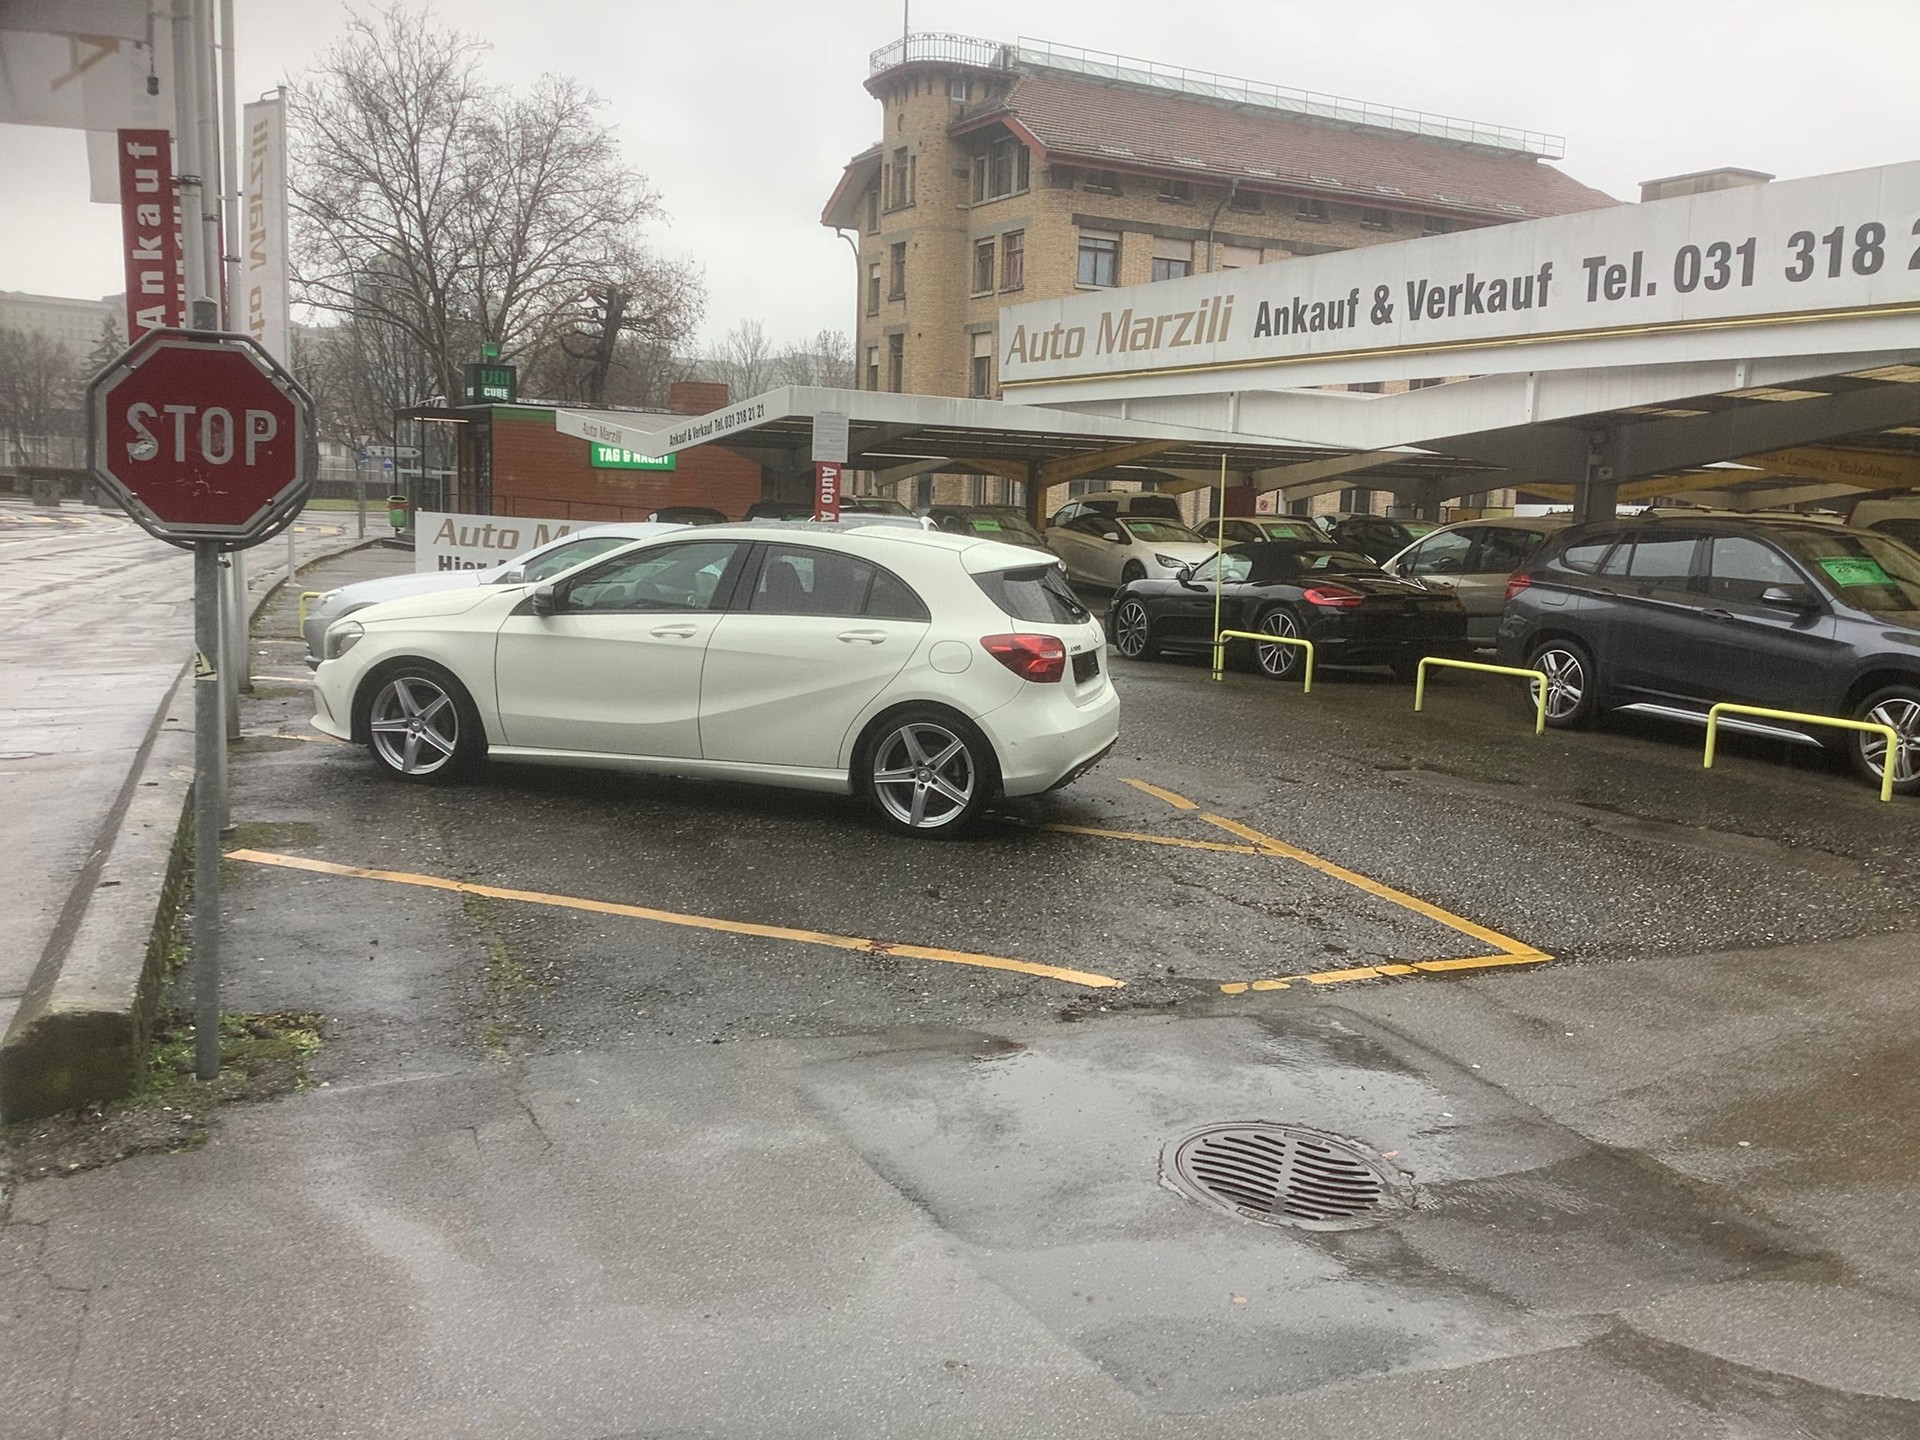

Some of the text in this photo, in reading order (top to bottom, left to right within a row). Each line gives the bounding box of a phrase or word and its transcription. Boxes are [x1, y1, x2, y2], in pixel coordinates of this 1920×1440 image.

[126, 141, 168, 330] Ankauf
[1005, 322, 1086, 365] Auto
[1096, 294, 1235, 356] Marzili
[1254, 288, 1359, 338] Ankauf
[1370, 285, 1394, 326] &
[1406, 261, 1553, 322] Verkauf
[1583, 250, 1657, 302] Tel.
[1674, 237, 1757, 294] 031
[1785, 222, 1886, 283] 318
[483, 387, 509, 400] CUBE
[126, 402, 278, 466] STOP
[582, 422, 622, 445] Auto Marzili
[669, 430, 687, 447] Ankauf
[692, 421, 713, 439] Verkauf
[714, 417, 724, 432] Tel.
[725, 414, 735, 429] 031
[736, 409, 747, 425] 318
[748, 406, 756, 421] 21
[757, 403, 765, 418] 21
[598, 448, 620, 462] TAG
[622, 449, 631, 463] &
[821, 466, 837, 504] Auto
[820, 510, 836, 522] A
[433, 518, 570, 550] Auto M
